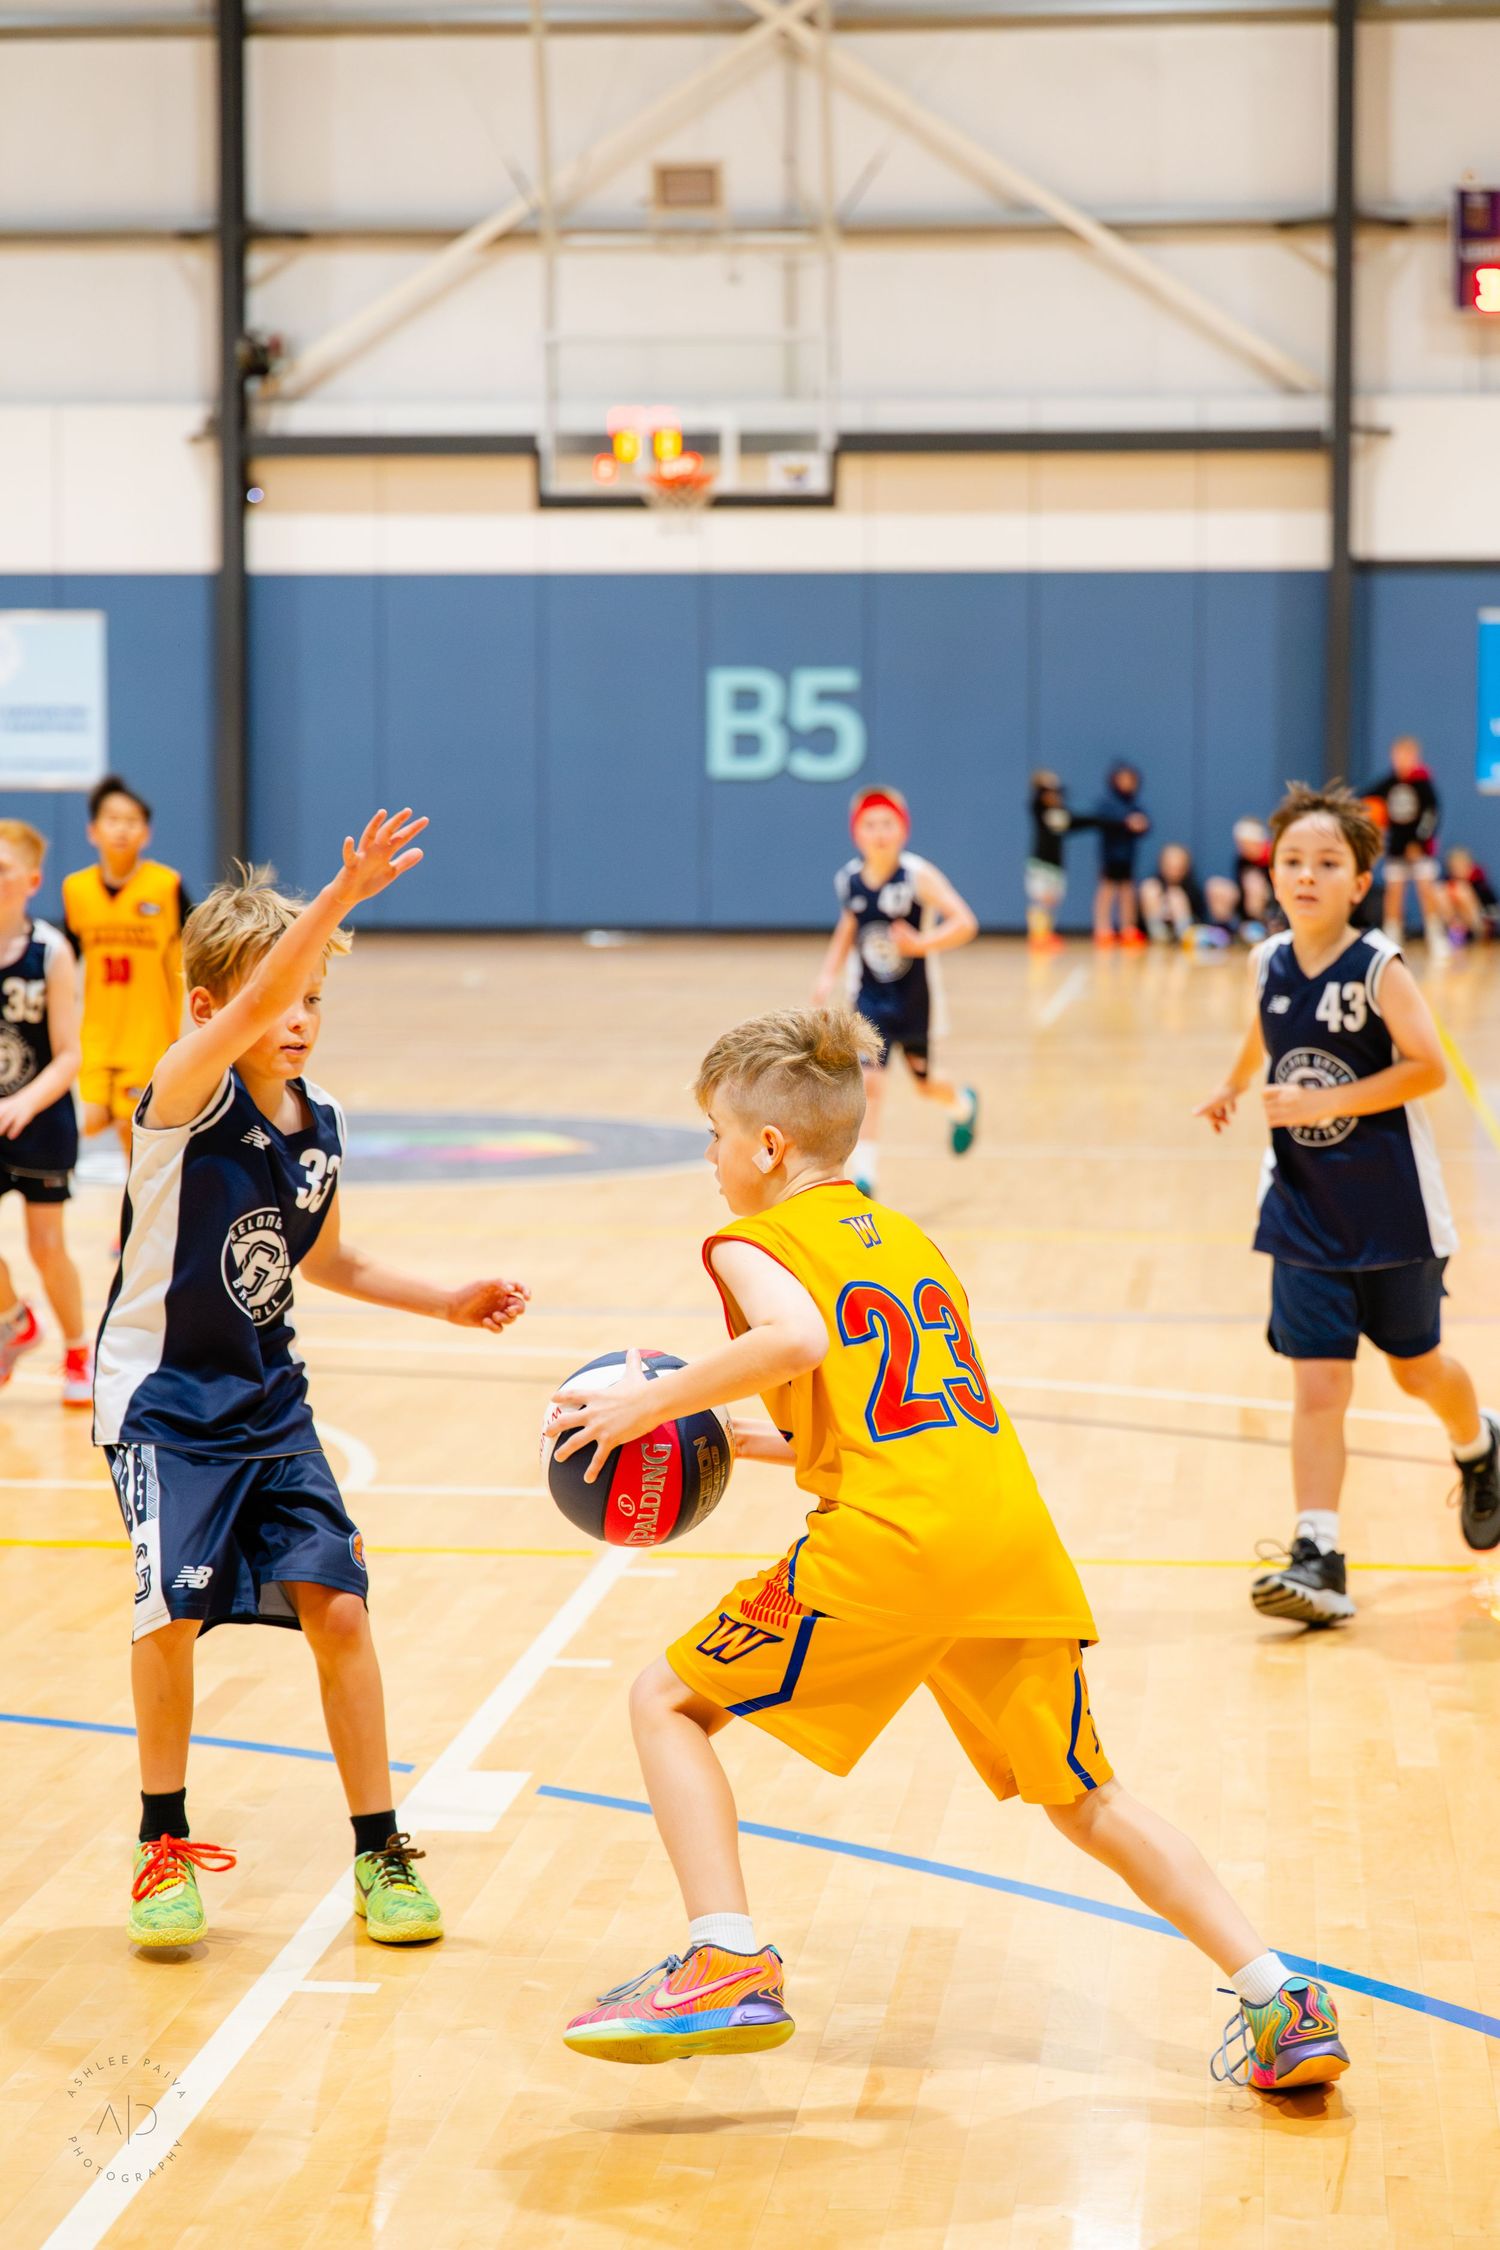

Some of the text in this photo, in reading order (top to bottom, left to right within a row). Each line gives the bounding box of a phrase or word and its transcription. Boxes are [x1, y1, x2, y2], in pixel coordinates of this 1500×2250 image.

[706, 666, 868, 782] B5
[1315, 981, 1368, 1033] 43
[838, 1213, 882, 1249] W
[836, 1277, 999, 1443] 23
[624, 1443, 672, 1545] SPALDING
[695, 1612, 785, 1665] W
